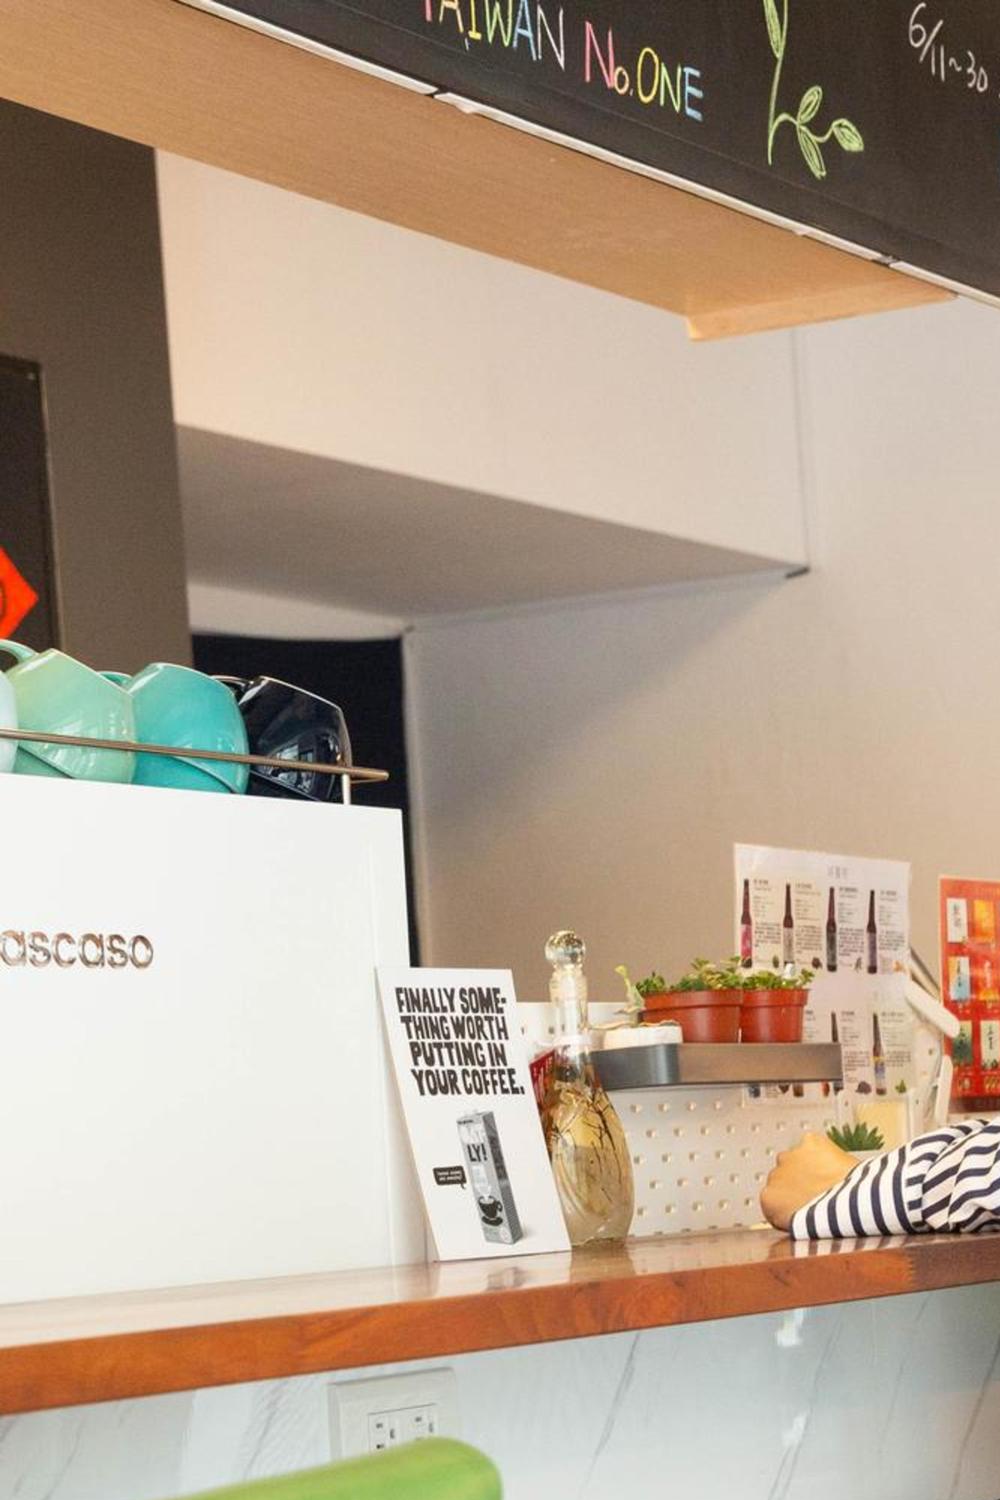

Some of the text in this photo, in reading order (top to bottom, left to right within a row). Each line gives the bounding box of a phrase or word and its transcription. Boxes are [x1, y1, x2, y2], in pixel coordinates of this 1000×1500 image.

[0, 929, 154, 969] ascaso
[395, 987, 507, 1014] FINALLY SOME-
[400, 1015, 509, 1041] THING WORTH
[409, 1041, 508, 1067] PUTTING IN
[410, 1068, 526, 1096] YOUR COFFEE.
